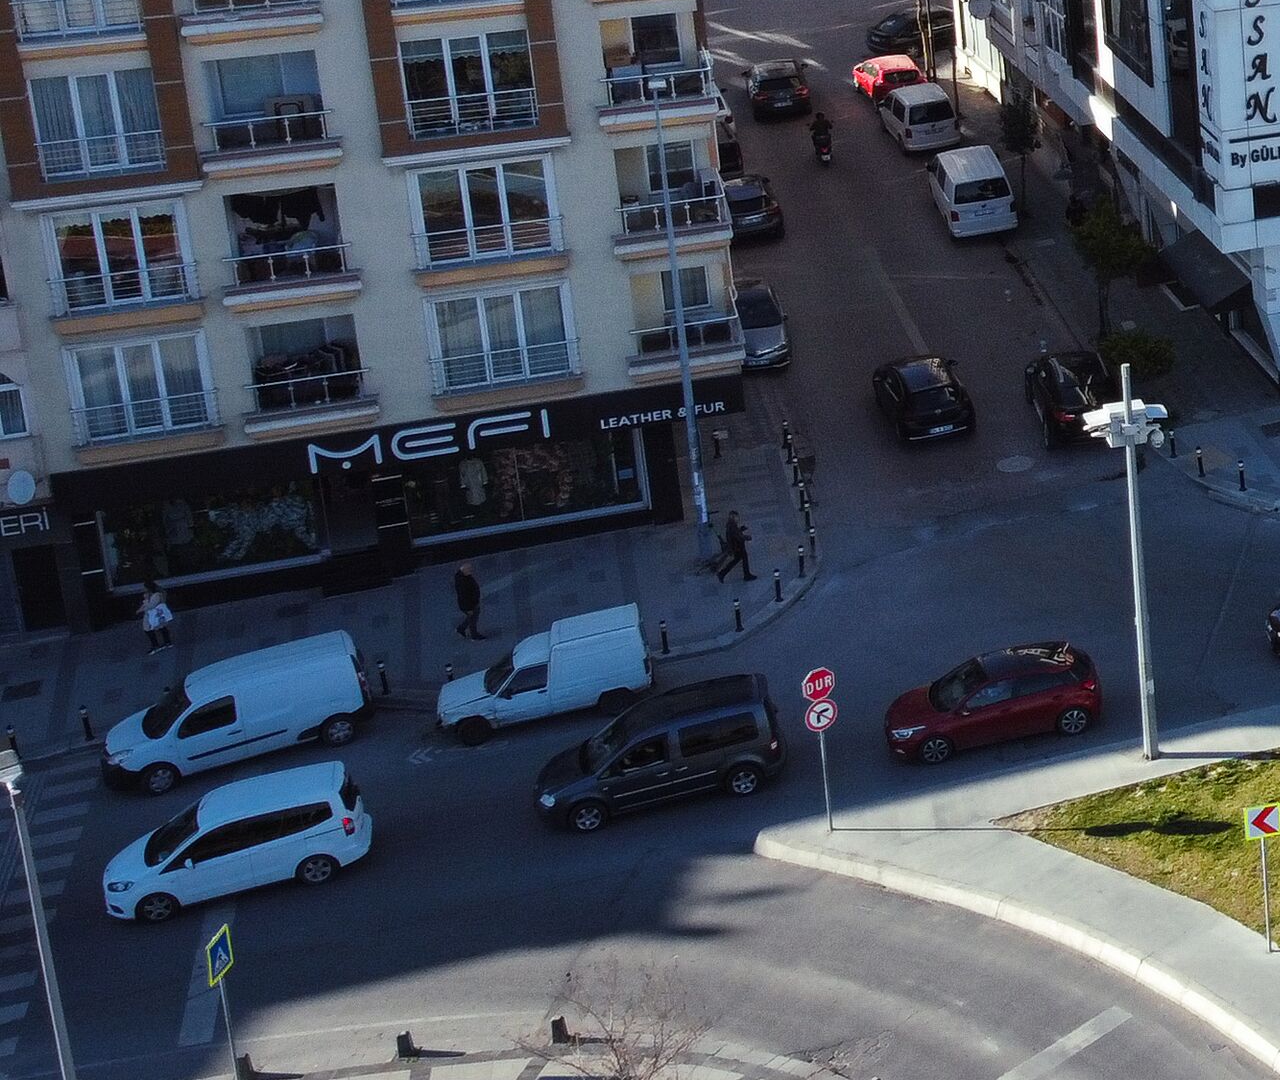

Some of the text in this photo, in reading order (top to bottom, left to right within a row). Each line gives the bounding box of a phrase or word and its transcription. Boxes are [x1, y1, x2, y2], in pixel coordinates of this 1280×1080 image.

[1231, 152, 1247, 168] By
[600, 409, 673, 430] LEATHER
[695, 401, 726, 416] FUR
[308, 408, 551, 474] MEFI
[806, 675, 832, 695] DUR
